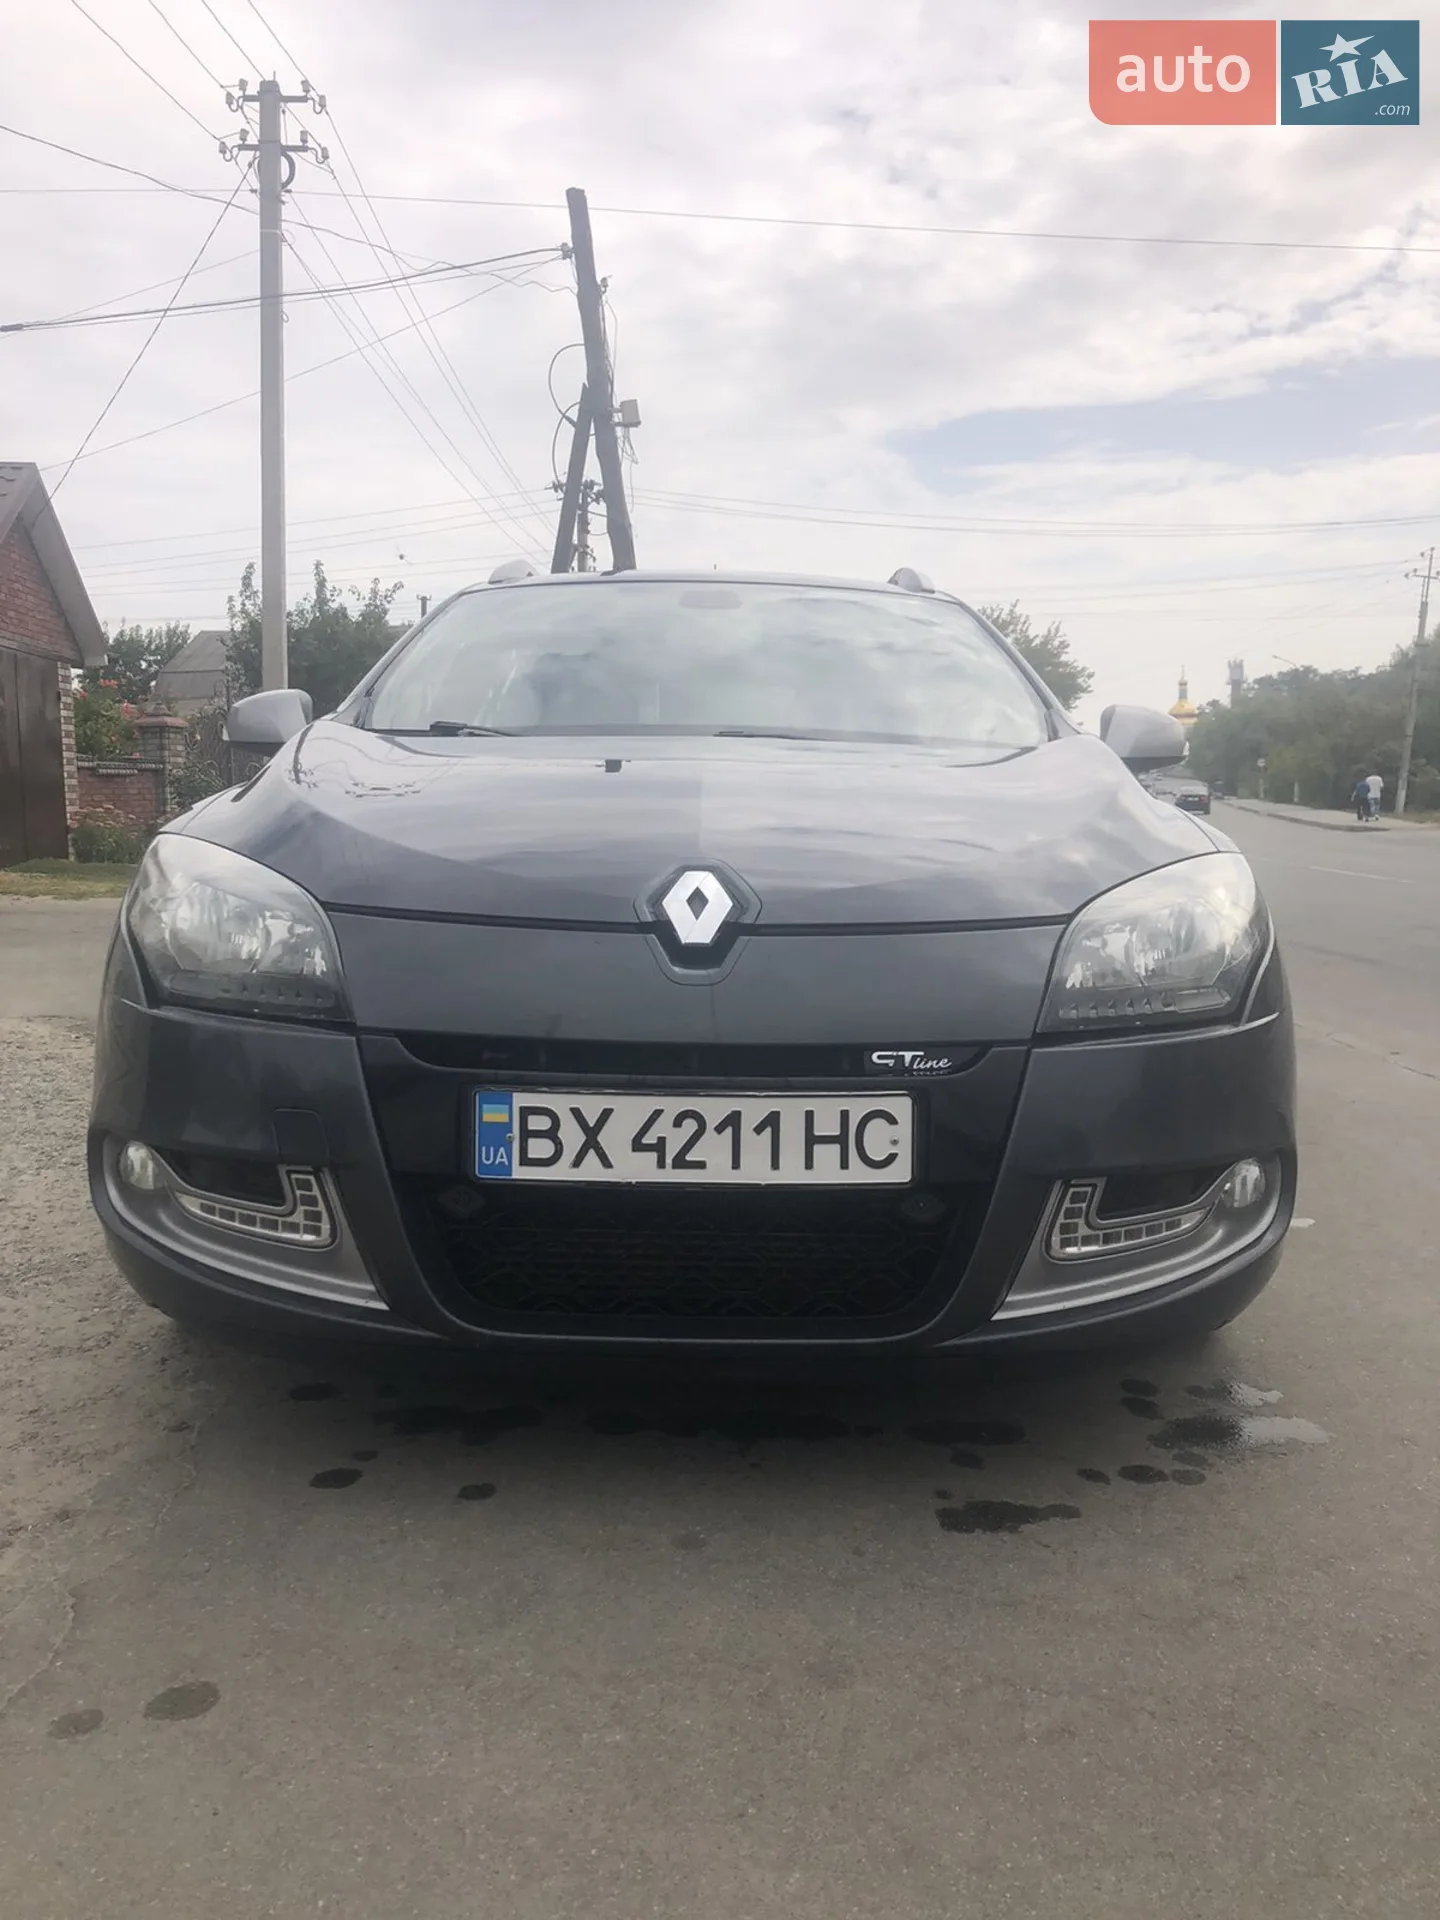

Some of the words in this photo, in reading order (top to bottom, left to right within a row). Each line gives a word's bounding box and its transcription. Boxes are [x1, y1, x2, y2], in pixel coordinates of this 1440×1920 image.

[481, 1145, 509, 1166] UA
[519, 1106, 615, 1169] BX
[631, 1108, 781, 1170] 4211
[804, 1109, 899, 1170] HC
